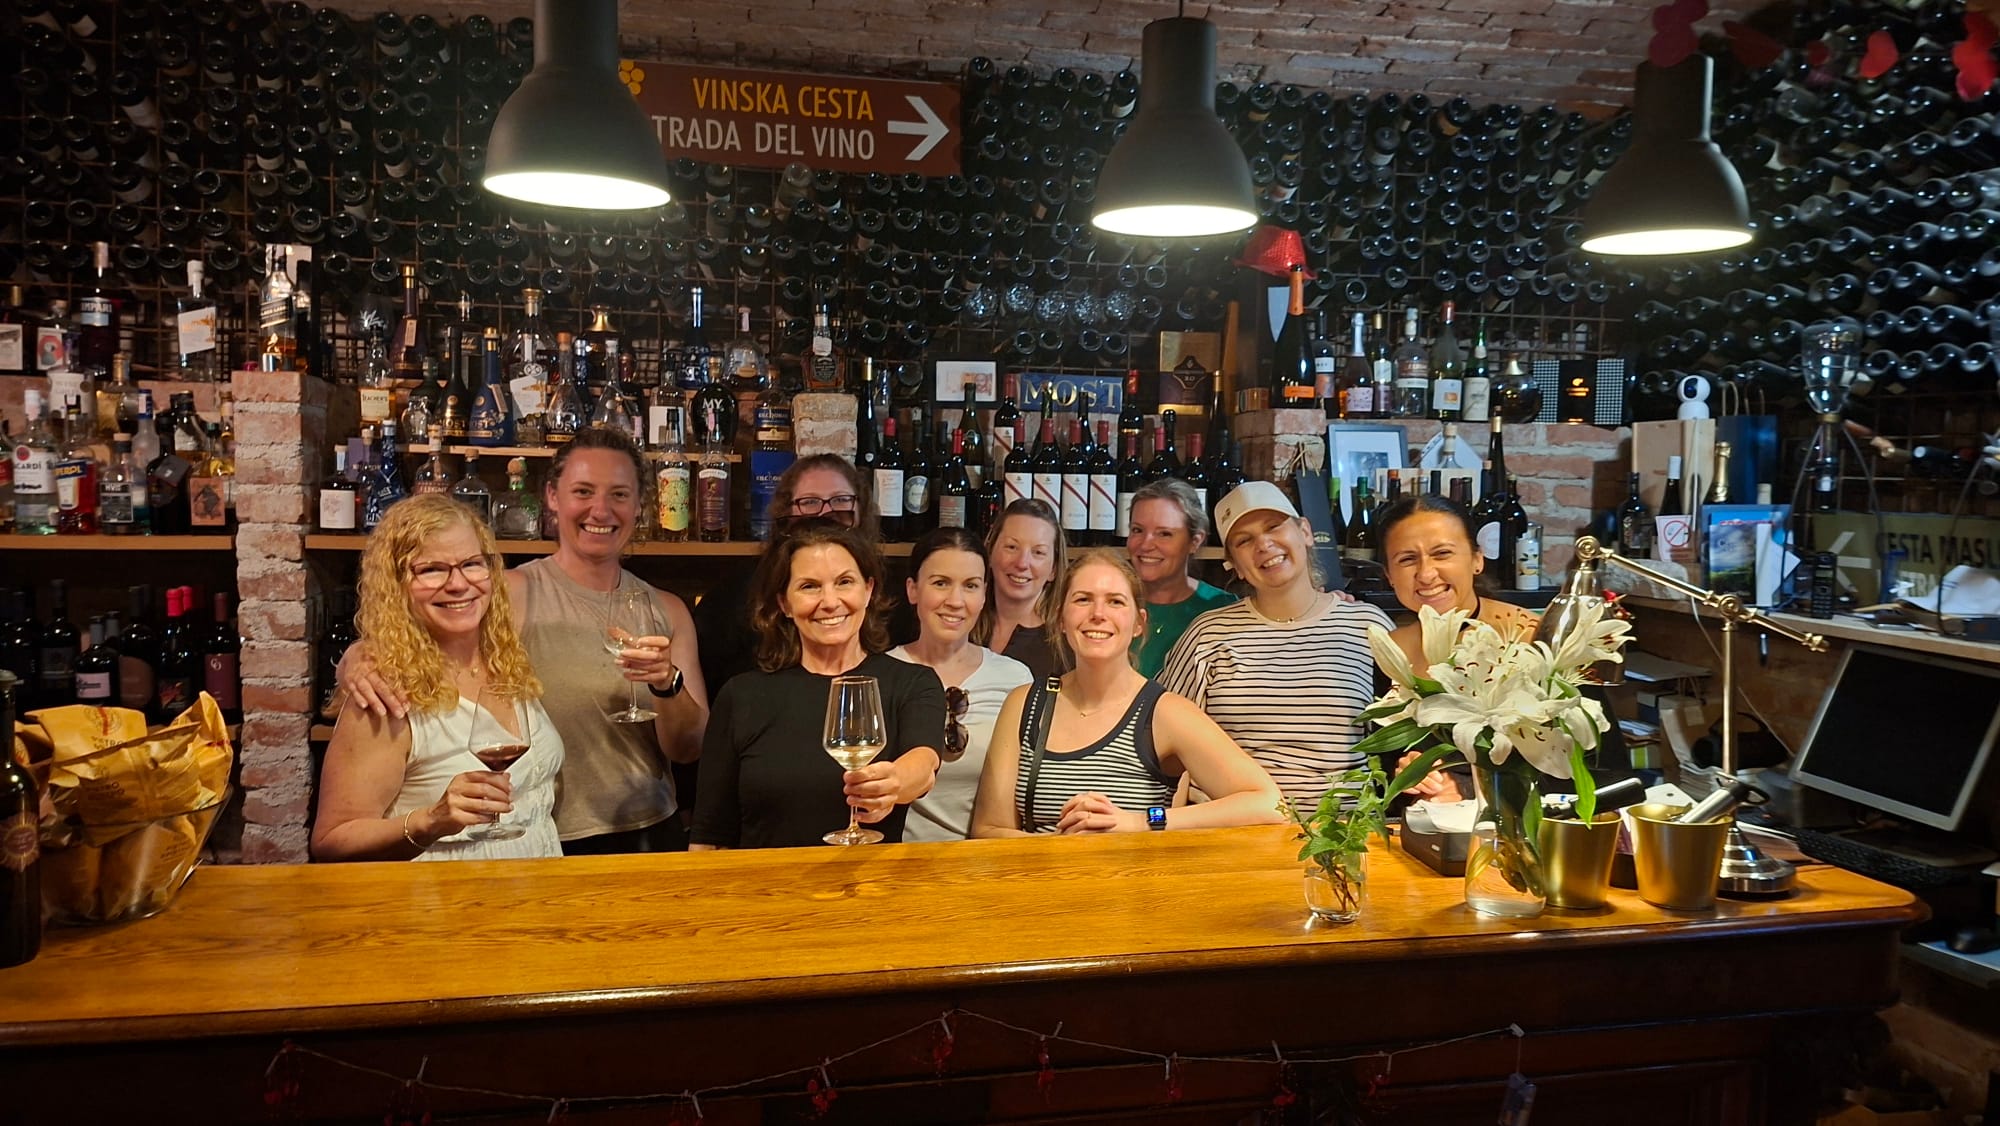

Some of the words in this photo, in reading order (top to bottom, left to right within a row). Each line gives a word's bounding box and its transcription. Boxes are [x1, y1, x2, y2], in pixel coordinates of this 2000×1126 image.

[692, 77, 790, 115] VINSKA
[797, 85, 875, 121] CESTA
[651, 115, 742, 151] TRADA
[755, 122, 805, 156] DEL
[812, 126, 875, 160] VINO
[1023, 378, 1122, 409] MOST
[1939, 535, 2000, 569] MASL
